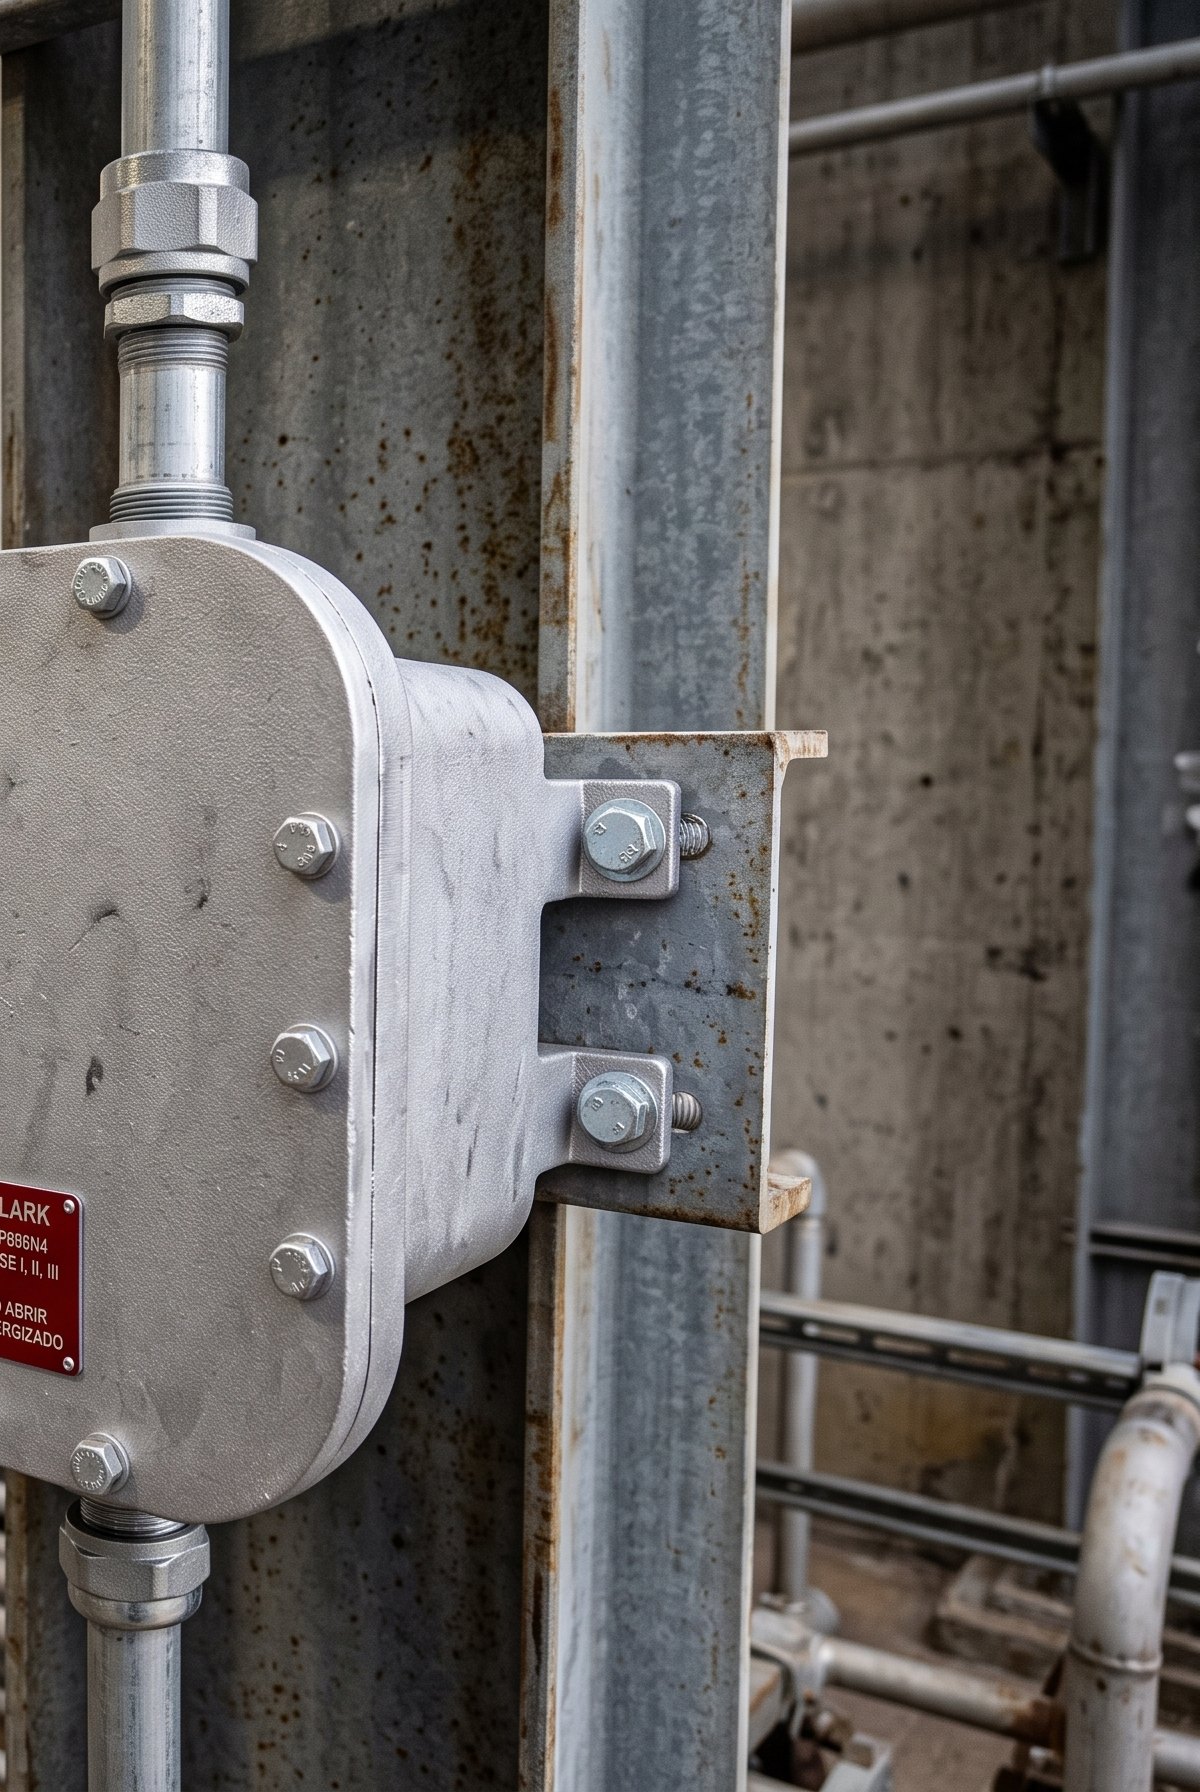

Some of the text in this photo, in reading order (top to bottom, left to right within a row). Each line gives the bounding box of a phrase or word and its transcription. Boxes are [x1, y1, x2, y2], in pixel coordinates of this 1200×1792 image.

[20, 1257, 28, 1276] I,
[32, 1260, 43, 1279] II,
[47, 1263, 59, 1280] III
[5, 1301, 47, 1325] ABRIR
